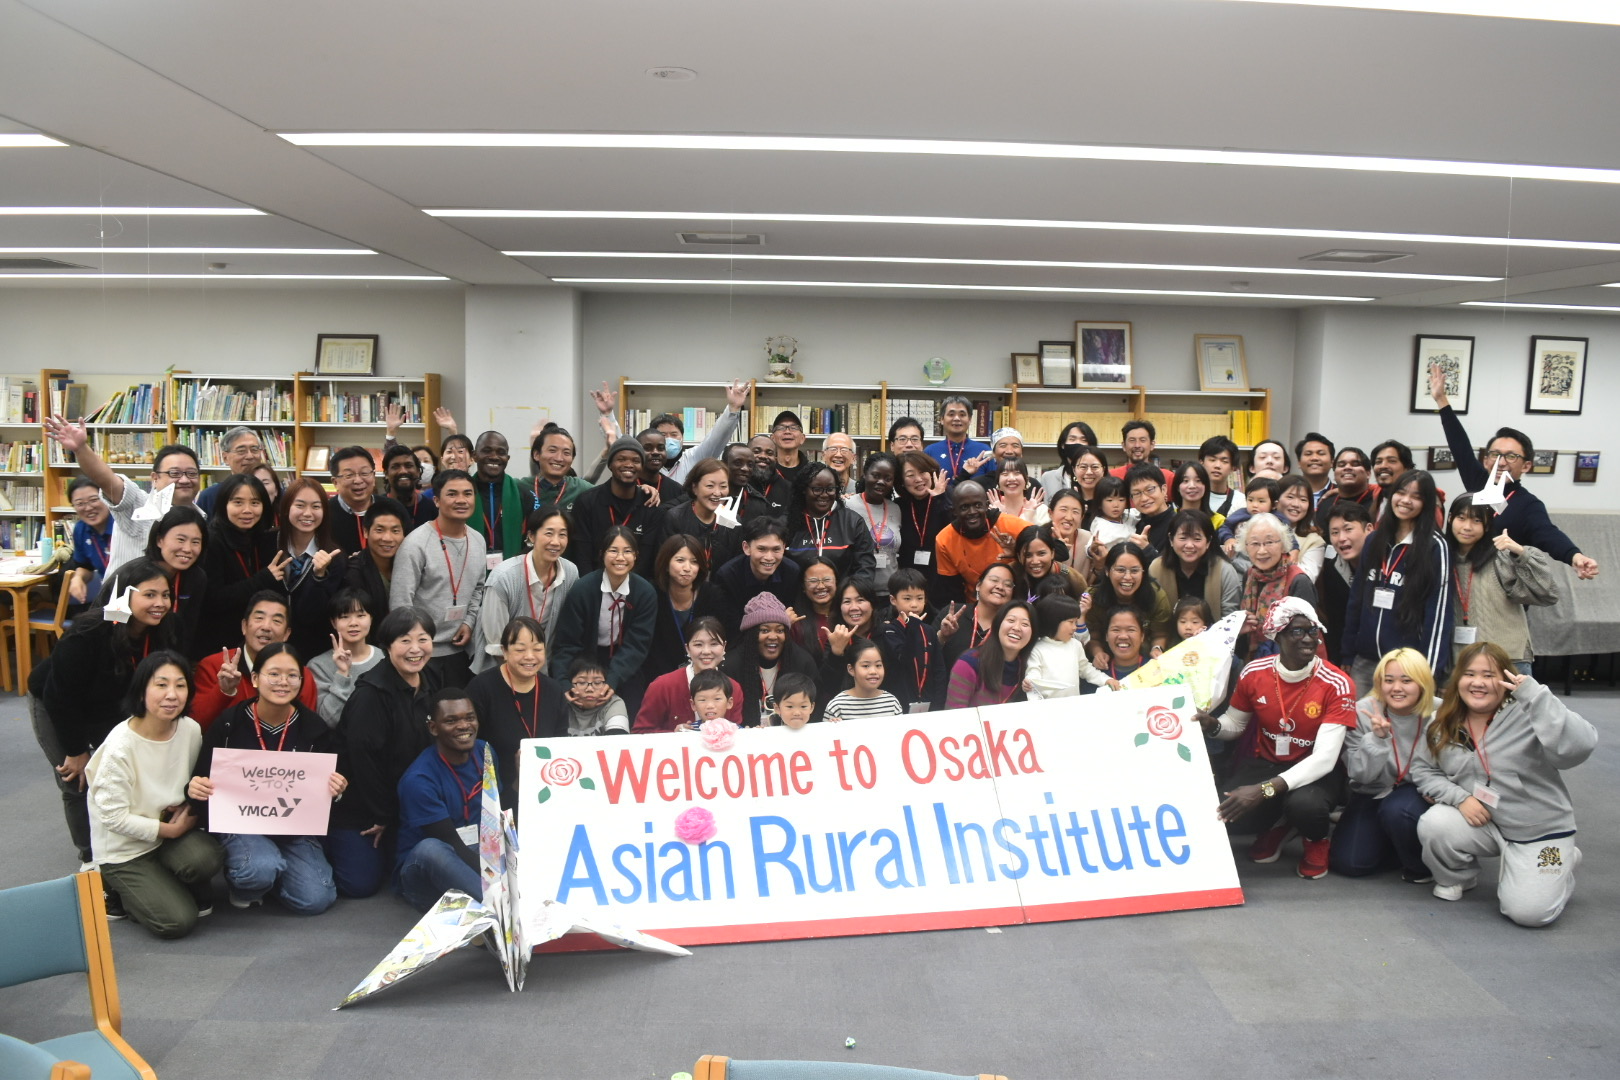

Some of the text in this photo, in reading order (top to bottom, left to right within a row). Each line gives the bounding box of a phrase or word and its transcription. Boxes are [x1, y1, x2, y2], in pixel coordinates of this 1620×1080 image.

[261, 780, 283, 789] TO
[596, 720, 1044, 804] Welcome to Osaka
[238, 805, 278, 817] YMCA
[556, 791, 1191, 906] Asian Rural Institute
